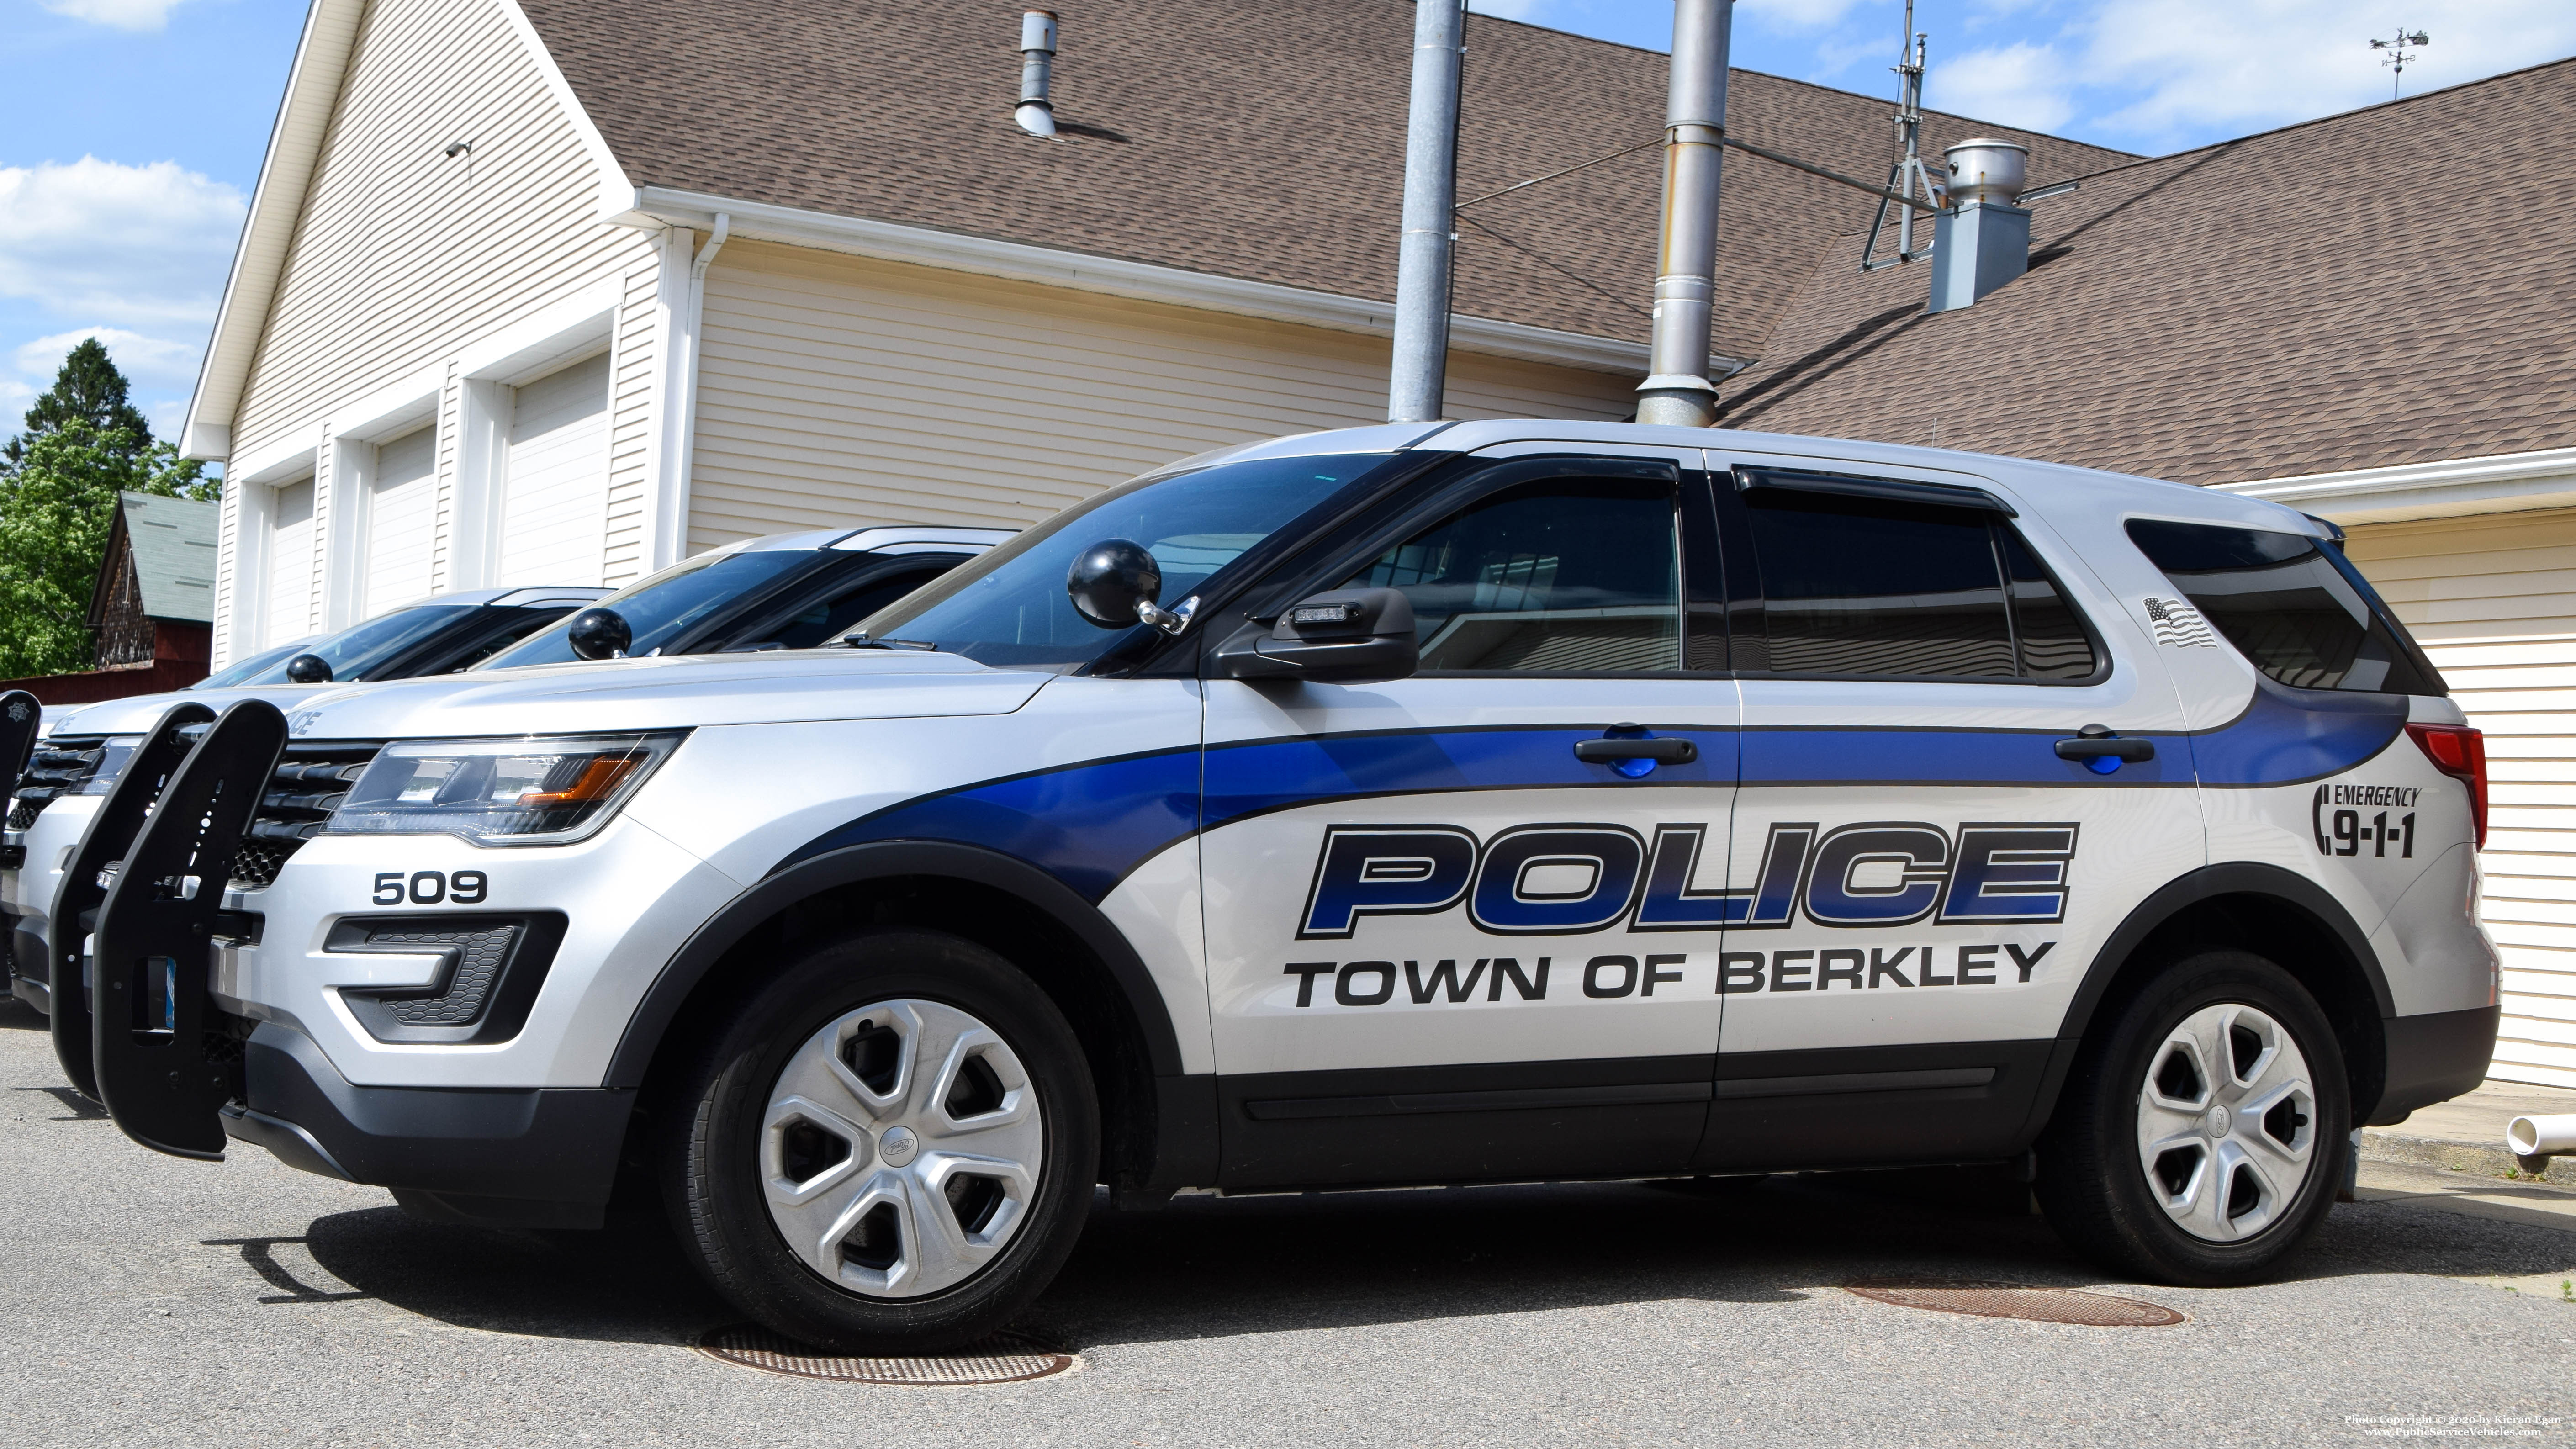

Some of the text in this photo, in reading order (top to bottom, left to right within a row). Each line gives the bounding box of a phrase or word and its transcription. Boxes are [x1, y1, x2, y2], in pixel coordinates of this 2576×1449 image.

[2334, 785, 2423, 807] EMERGENCY
[2333, 809, 2415, 858] 9-1-1
[372, 870, 488, 905] 509
[1295, 822, 2080, 941] POLICE
[1283, 942, 2057, 1009] TOWN OF BERKLEY
